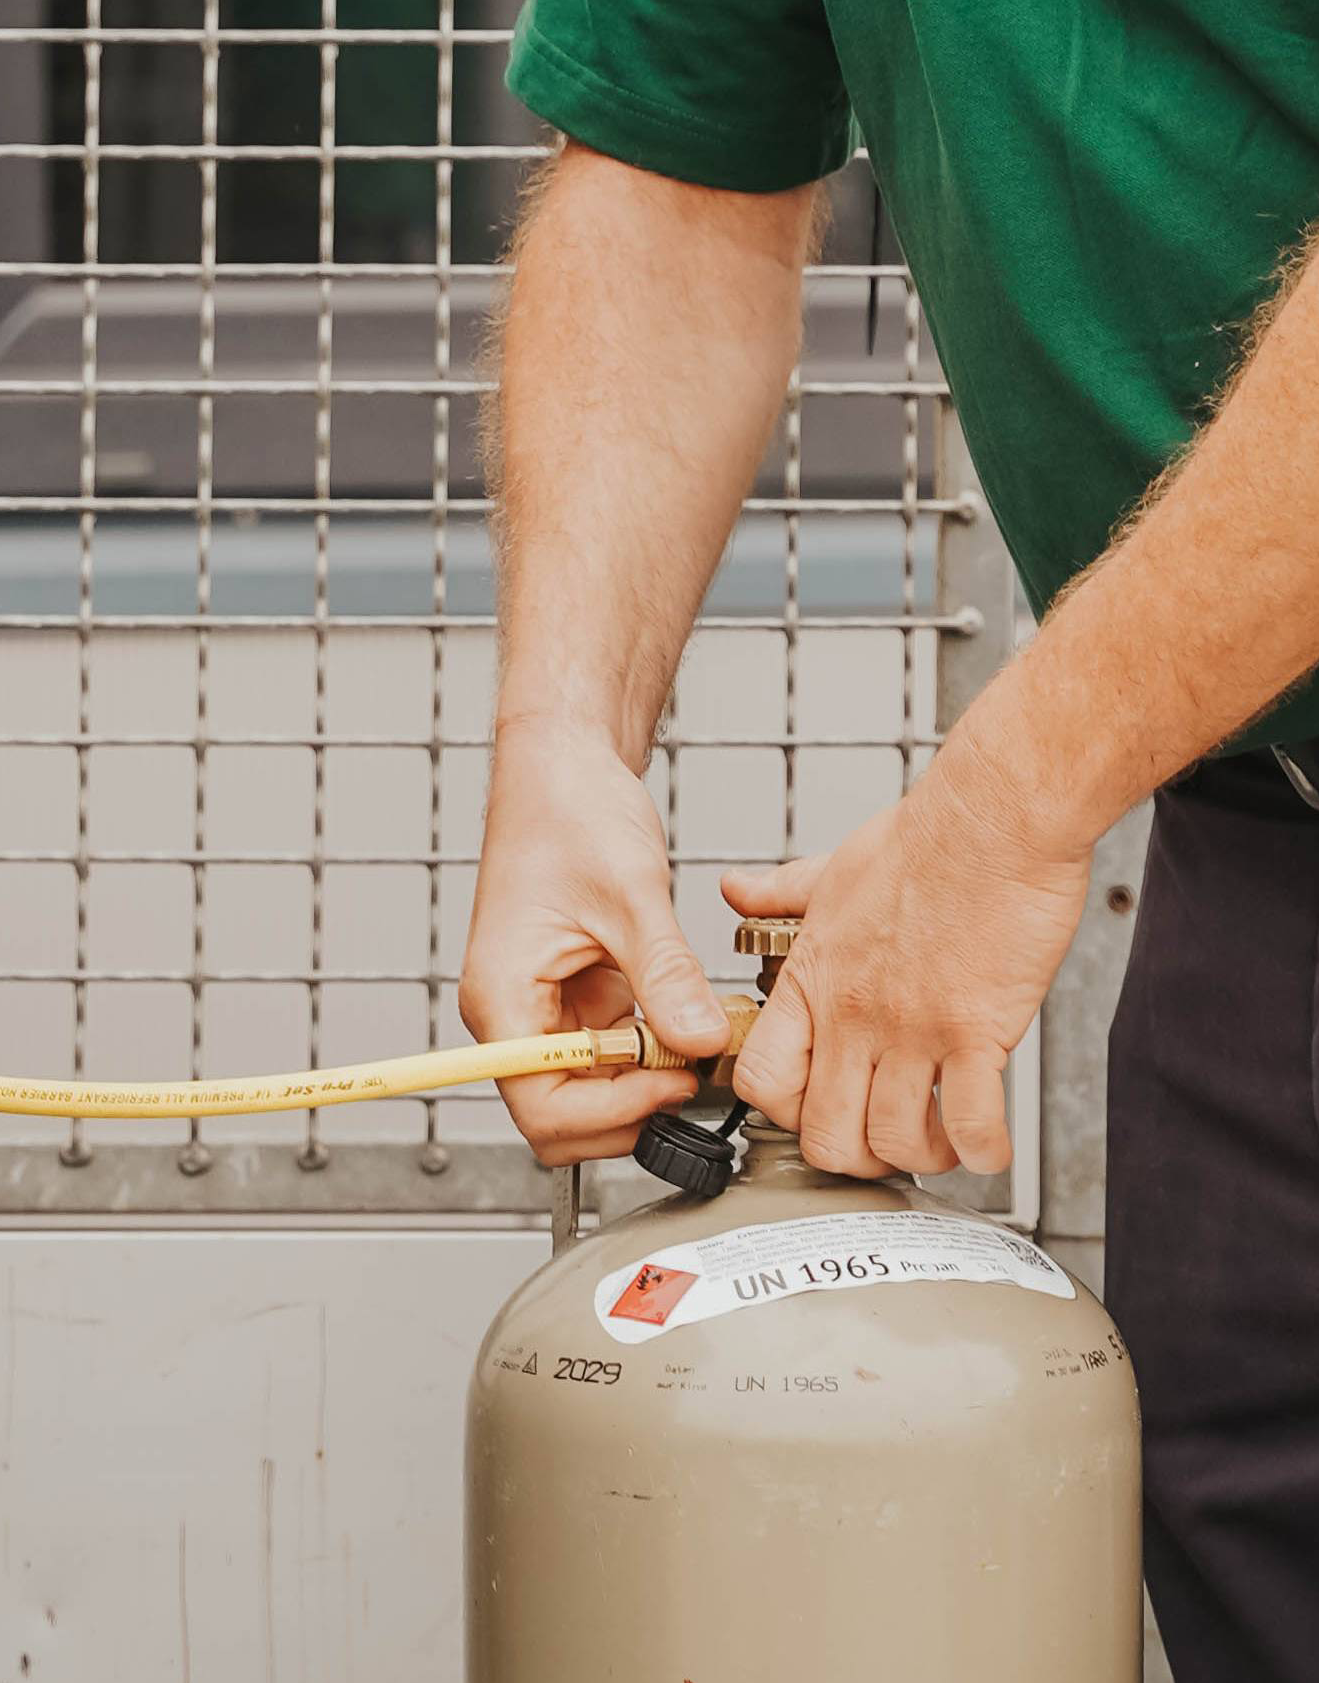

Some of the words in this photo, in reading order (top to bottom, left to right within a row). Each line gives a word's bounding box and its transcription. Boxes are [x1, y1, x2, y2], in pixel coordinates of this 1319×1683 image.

[20, 1089, 73, 1102] BARRIER
[78, 1092, 160, 1104] REFRIGERANT
[166, 1093, 185, 1103] ALL
[190, 1092, 244, 1103] PREMIUM
[733, 1268, 788, 1300] UN
[798, 1253, 890, 1285] 1965
[553, 1357, 622, 1385] 2029
[735, 1376, 765, 1392] UN
[782, 1375, 840, 1392] 1965
